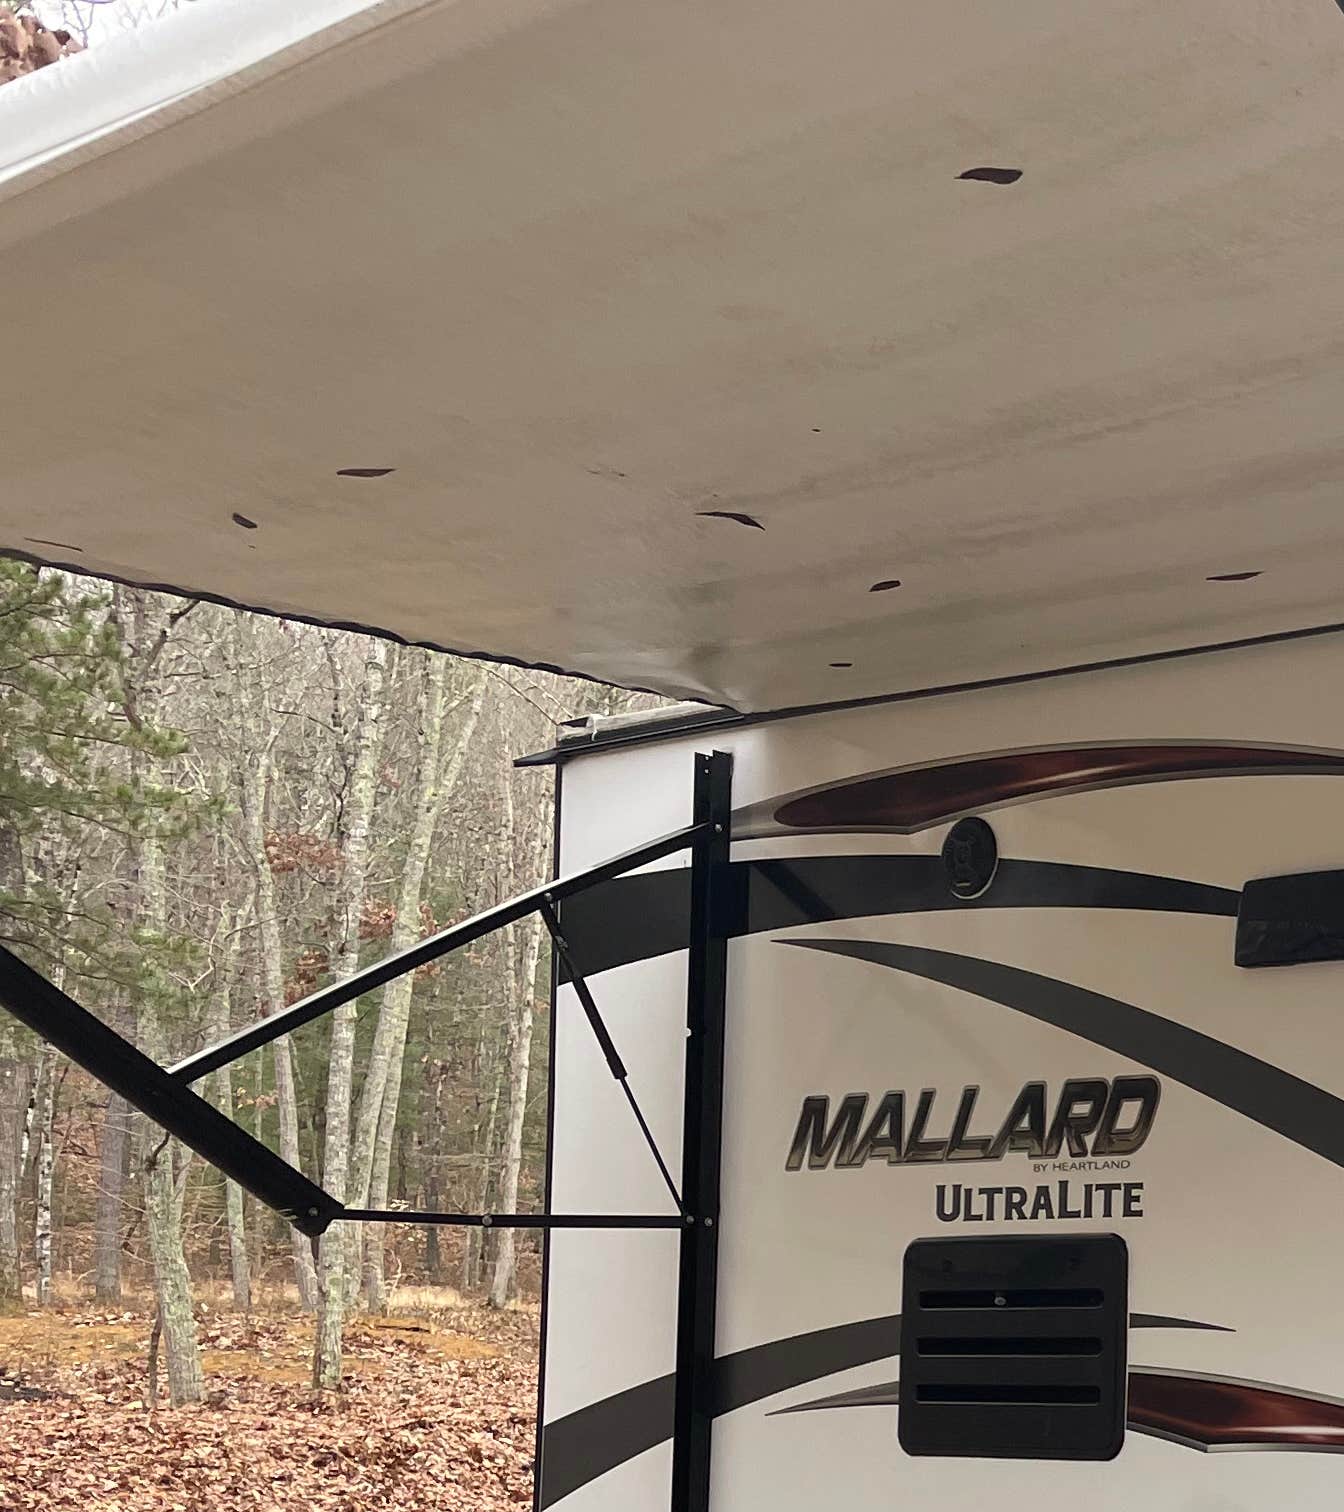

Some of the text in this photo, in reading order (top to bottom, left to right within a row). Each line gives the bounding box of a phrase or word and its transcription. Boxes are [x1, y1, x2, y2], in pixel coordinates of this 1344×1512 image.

[785, 1074, 1161, 1171] MALLARD
[1033, 1160, 1131, 1173] BY HEARTLAND
